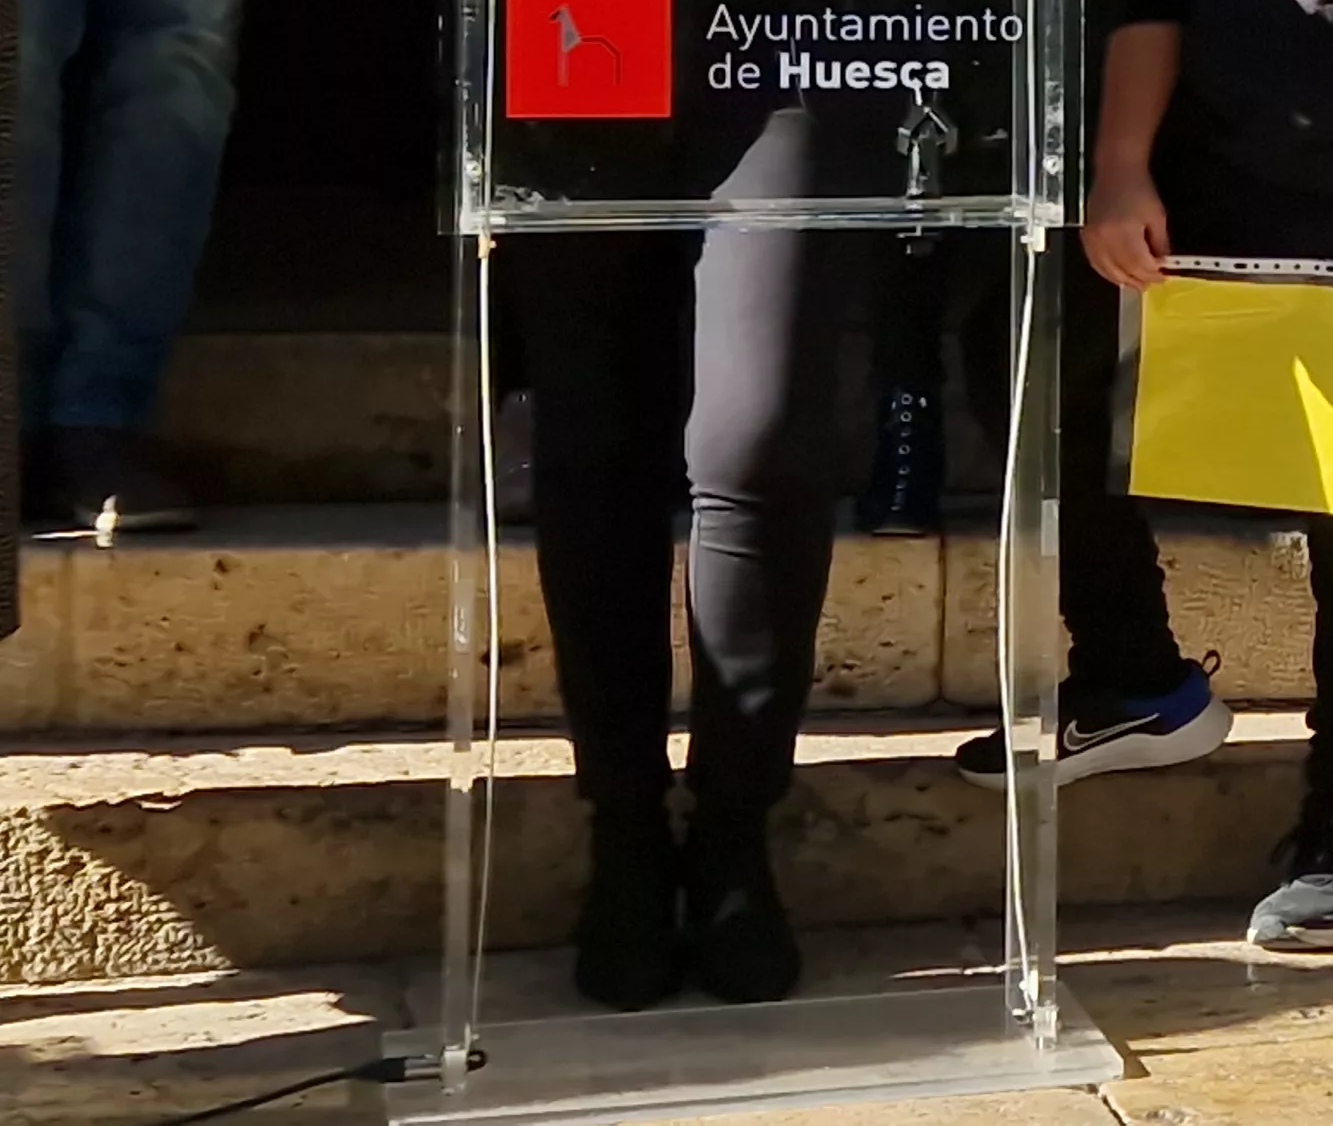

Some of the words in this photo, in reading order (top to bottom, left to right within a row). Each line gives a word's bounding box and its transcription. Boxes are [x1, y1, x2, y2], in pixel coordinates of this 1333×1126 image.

[706, 4, 1025, 51] Ayuntamiento
[708, 50, 762, 91] de
[779, 51, 951, 91] Huesca
